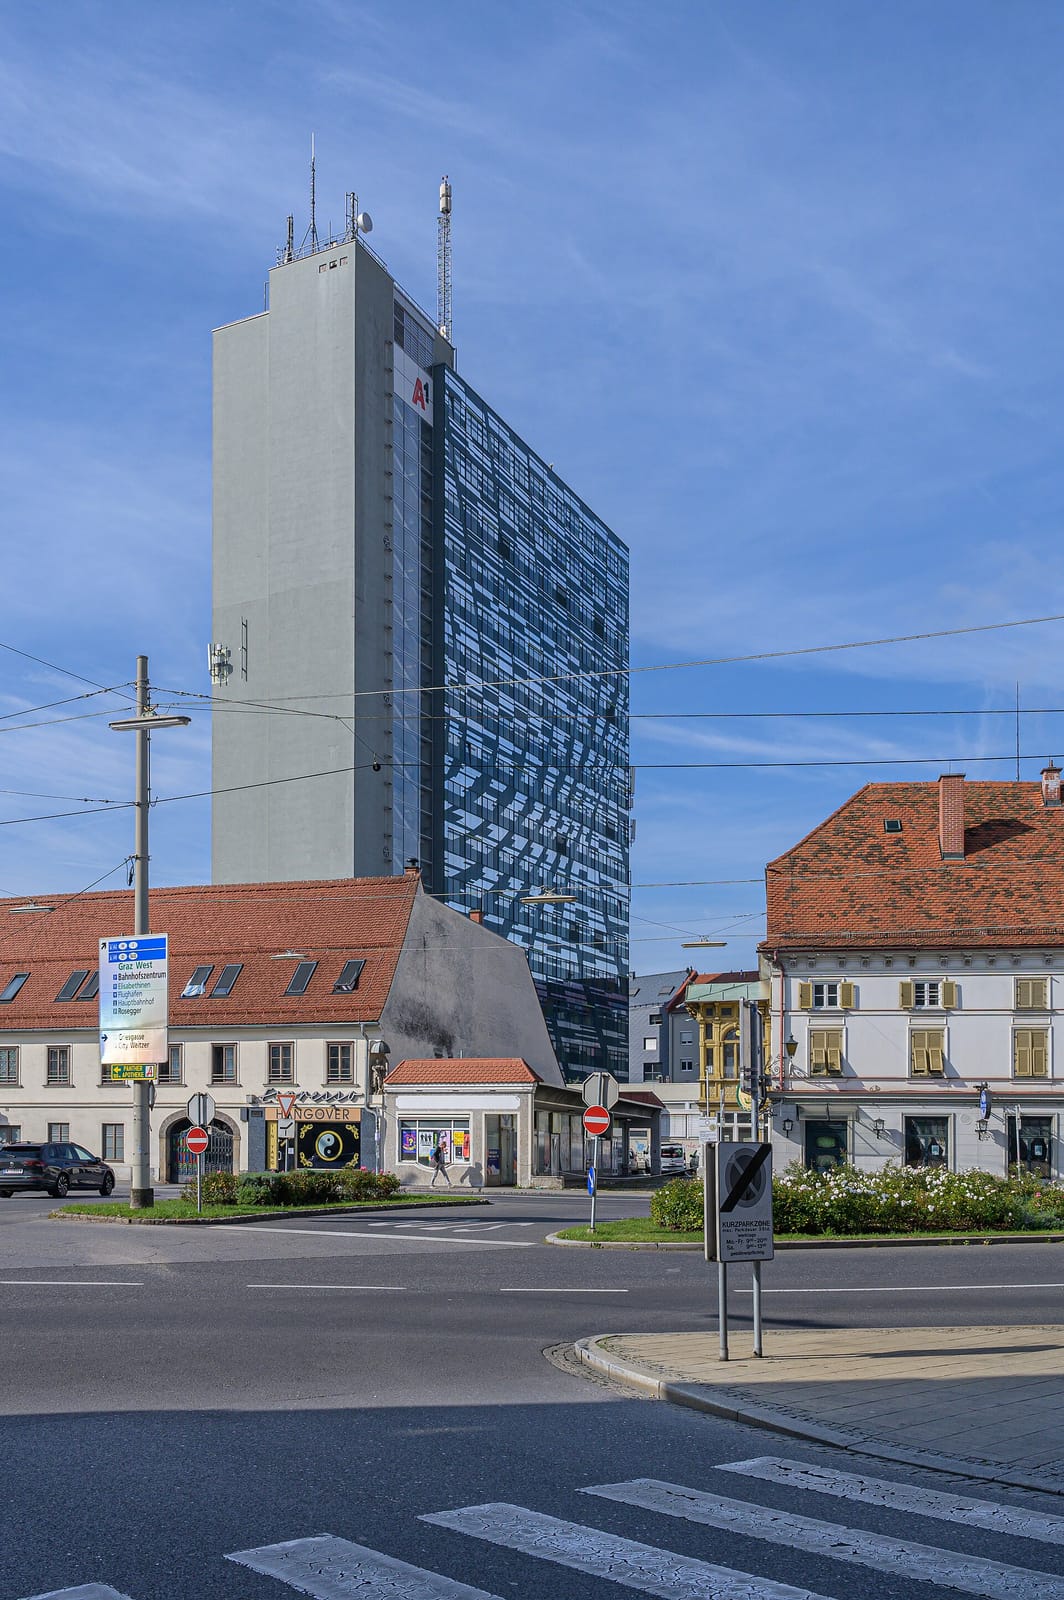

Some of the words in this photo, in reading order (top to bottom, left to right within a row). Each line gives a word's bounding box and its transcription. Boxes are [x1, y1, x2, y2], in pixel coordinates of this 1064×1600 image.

[412, 377, 429, 411] A1
[118, 962, 133, 970] Graz
[136, 961, 153, 969] West
[118, 971, 166, 981] Bahnhofszentrum
[118, 982, 151, 990] Elisabethinen
[118, 990, 143, 999] Flughafen
[118, 998, 155, 1007] Hauptbahnhof
[118, 1008, 142, 1016] Rosegger
[722, 1220, 771, 1228] KURZPARKZONE
